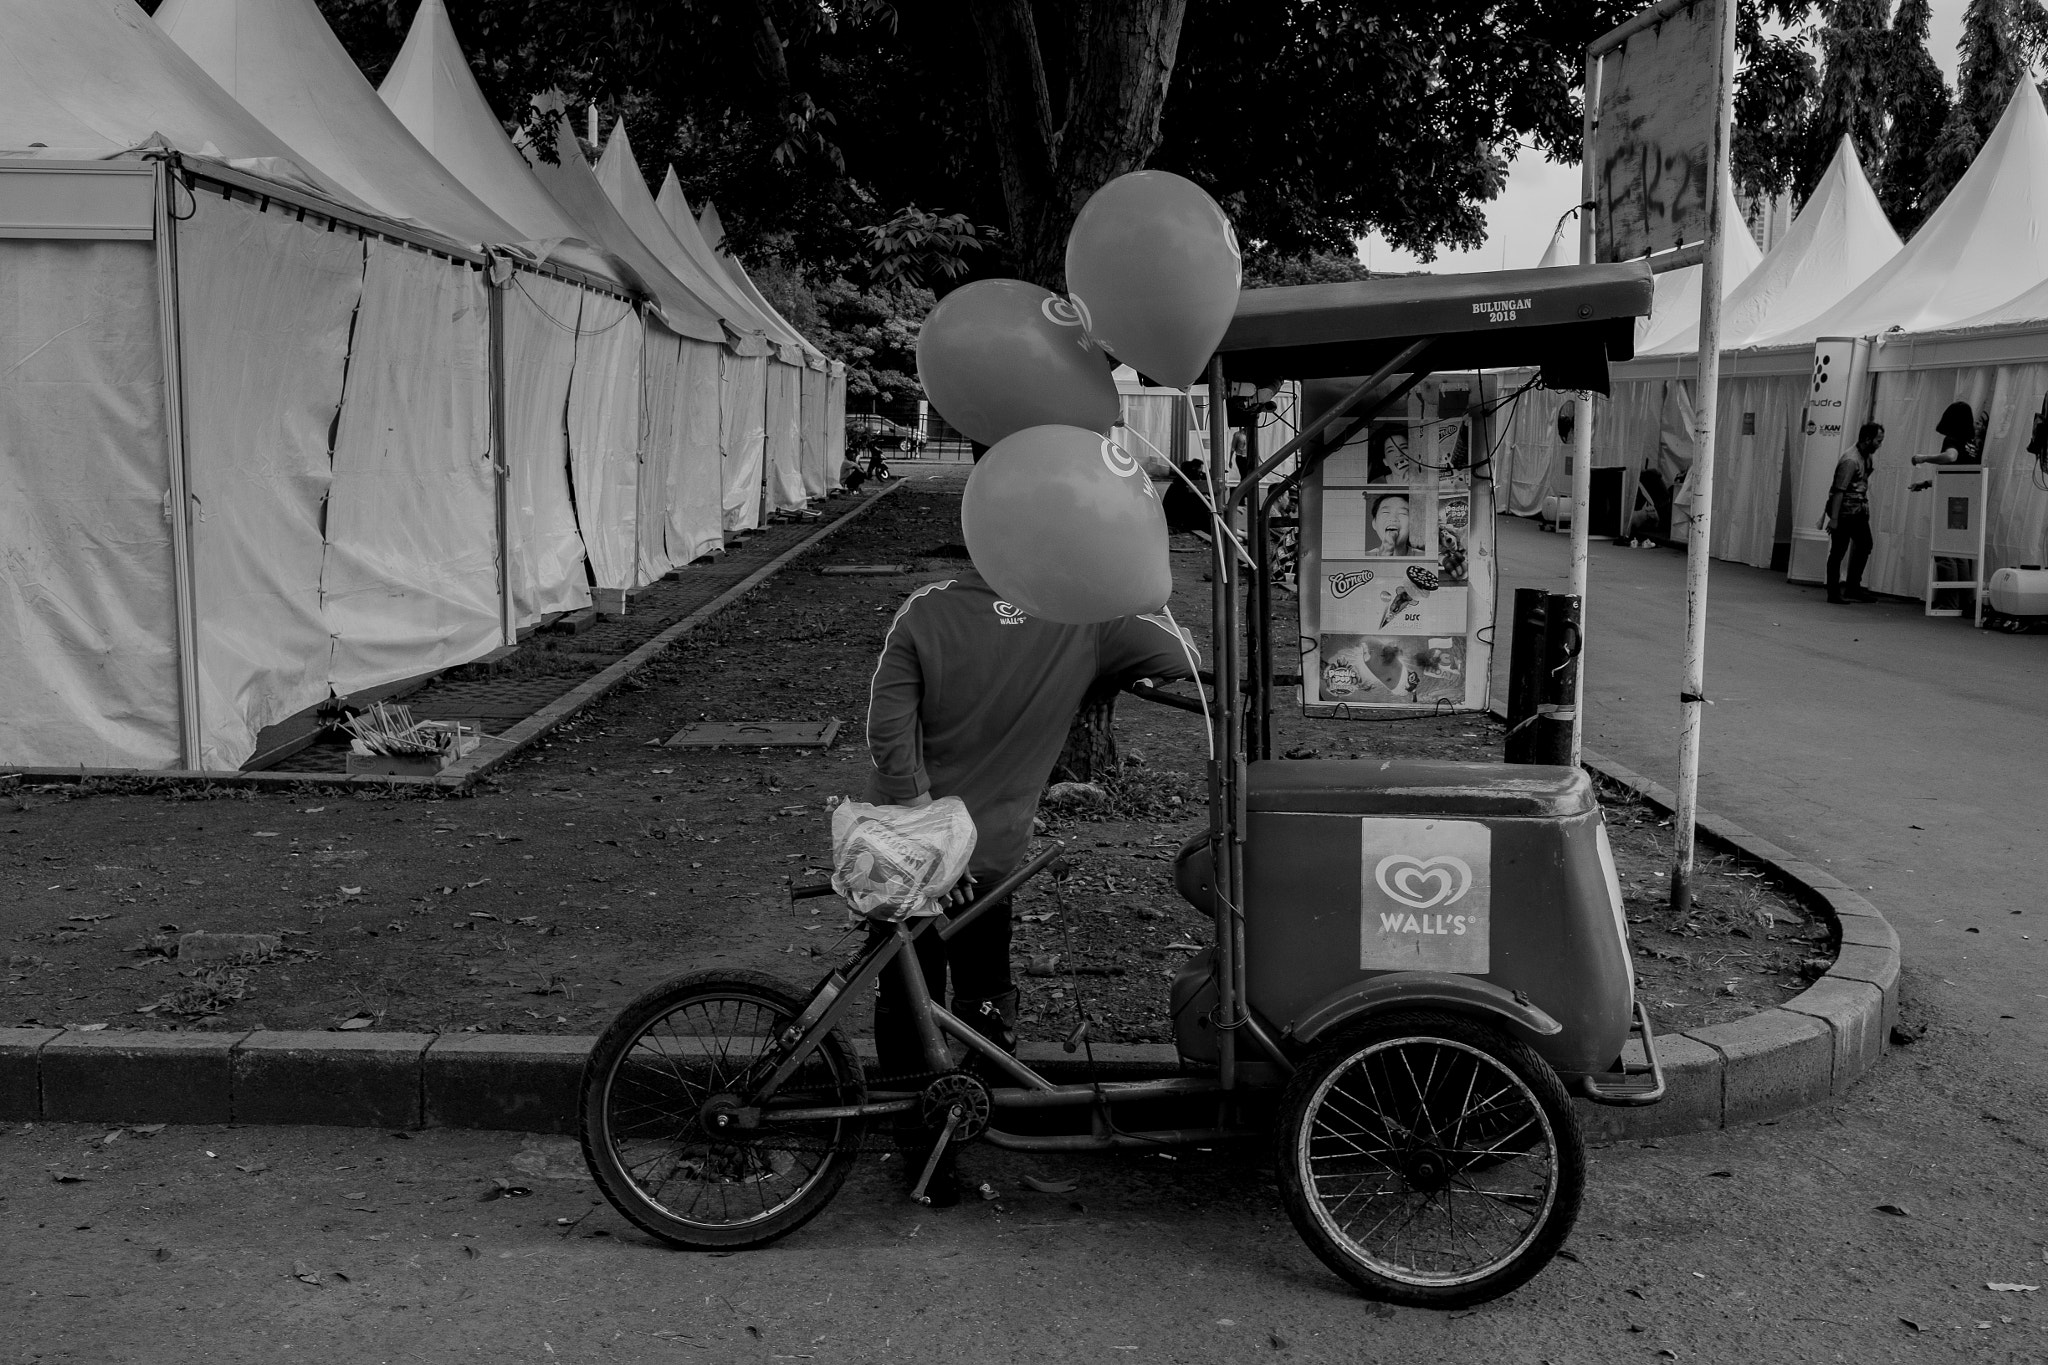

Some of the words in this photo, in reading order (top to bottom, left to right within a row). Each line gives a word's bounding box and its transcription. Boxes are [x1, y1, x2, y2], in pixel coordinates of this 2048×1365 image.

[1472, 298, 1532, 314] BULUNGAN
[1489, 311, 1517, 323] 2018
[1329, 570, 1374, 599] Cornetto
[999, 617, 1024, 625] WALL'S
[1380, 912, 1467, 936] WALL'S
